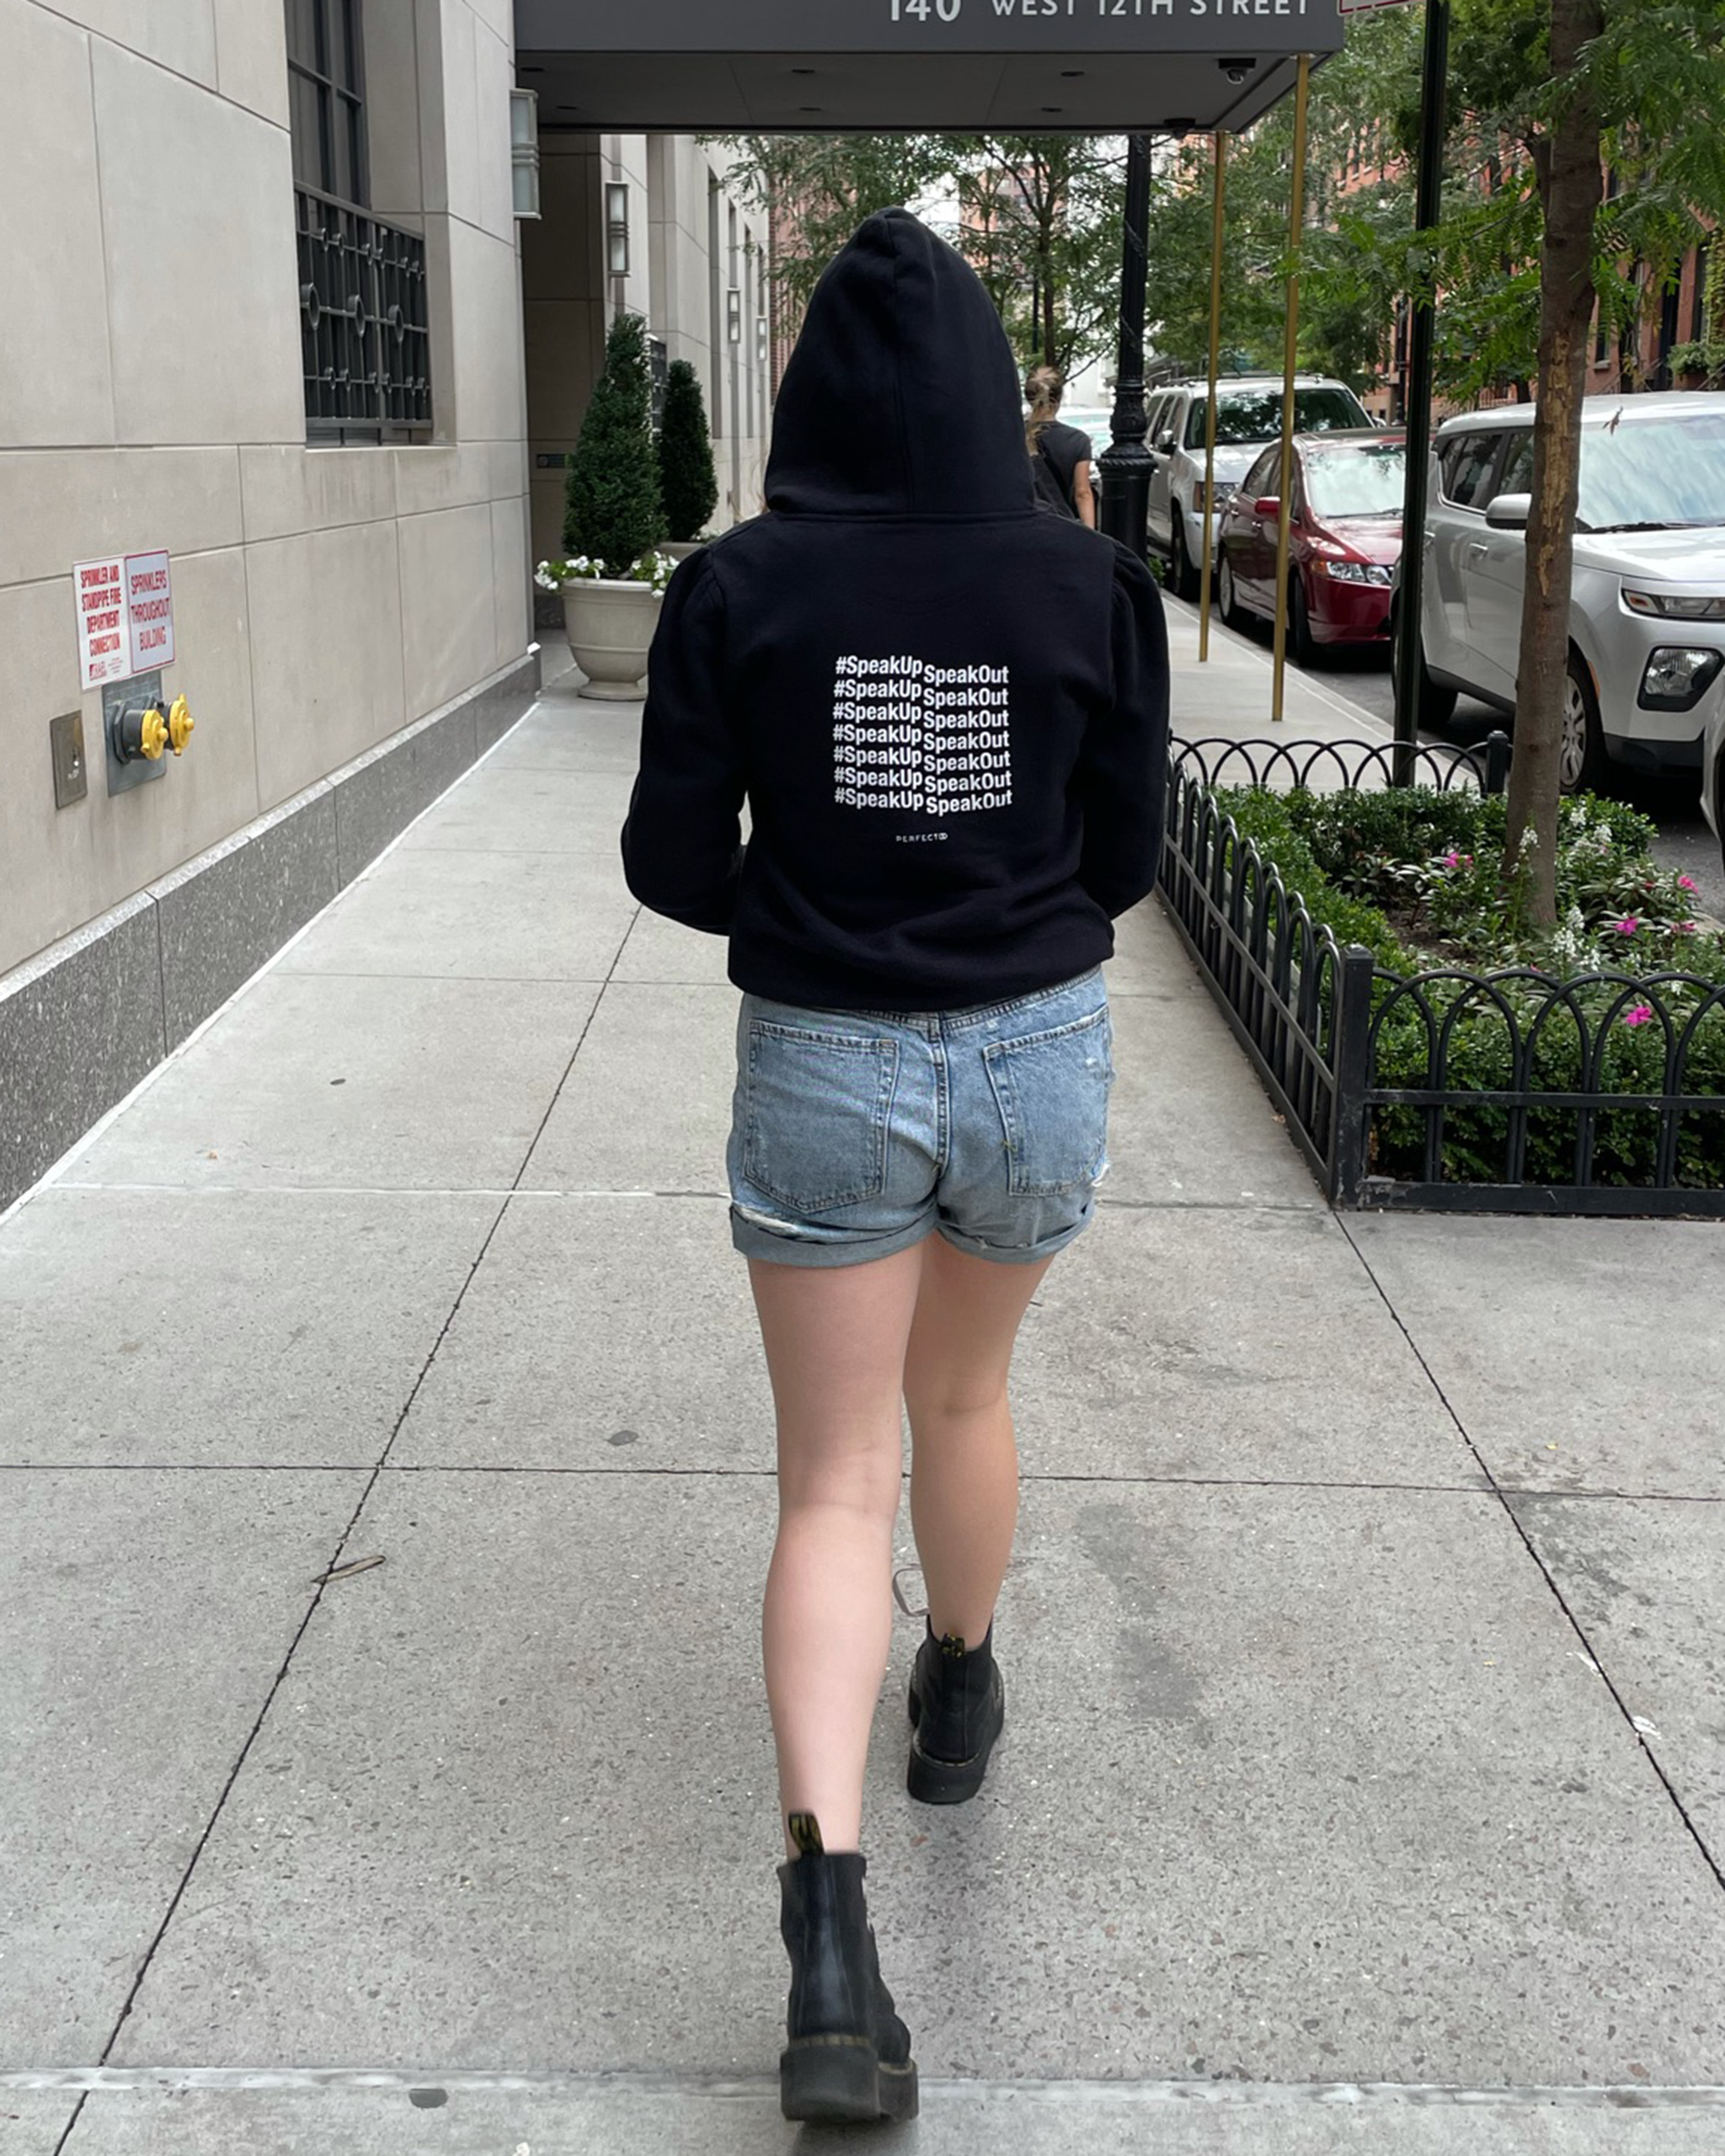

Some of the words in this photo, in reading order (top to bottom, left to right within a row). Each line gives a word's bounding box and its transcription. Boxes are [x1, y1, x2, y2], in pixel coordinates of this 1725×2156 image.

[890, 0, 962, 22] 140
[991, 0, 1074, 16] WEST
[1098, 0, 1173, 15] 12TH
[1189, 0, 1307, 15] STREET
[131, 570, 167, 595] SPRINKLERS
[87, 610, 120, 633] DEPARTMENT
[131, 597, 170, 623] THROUGHOUT
[89, 632, 120, 656] CONNECTION
[140, 626, 166, 651] BUILDING
[836, 655, 922, 679] #SpeakUp
[923, 664, 1009, 687] SpeakOut
[834, 679, 922, 702] #SpeakUp
[923, 687, 1009, 710] SpeakOut
[833, 702, 922, 724] #SpeakUp
[923, 709, 1009, 733] SpeakOut
[833, 724, 922, 747] #SpeakUp
[923, 731, 1010, 755] SpeakOut
[833, 746, 922, 768] #SpeakUp
[923, 750, 1011, 776] SpeakOut
[834, 766, 923, 790] #SpeakUp
[925, 770, 1012, 796] SpeakOut
[834, 787, 924, 812] #SpeakUp
[926, 789, 1013, 817] SpeakOut
